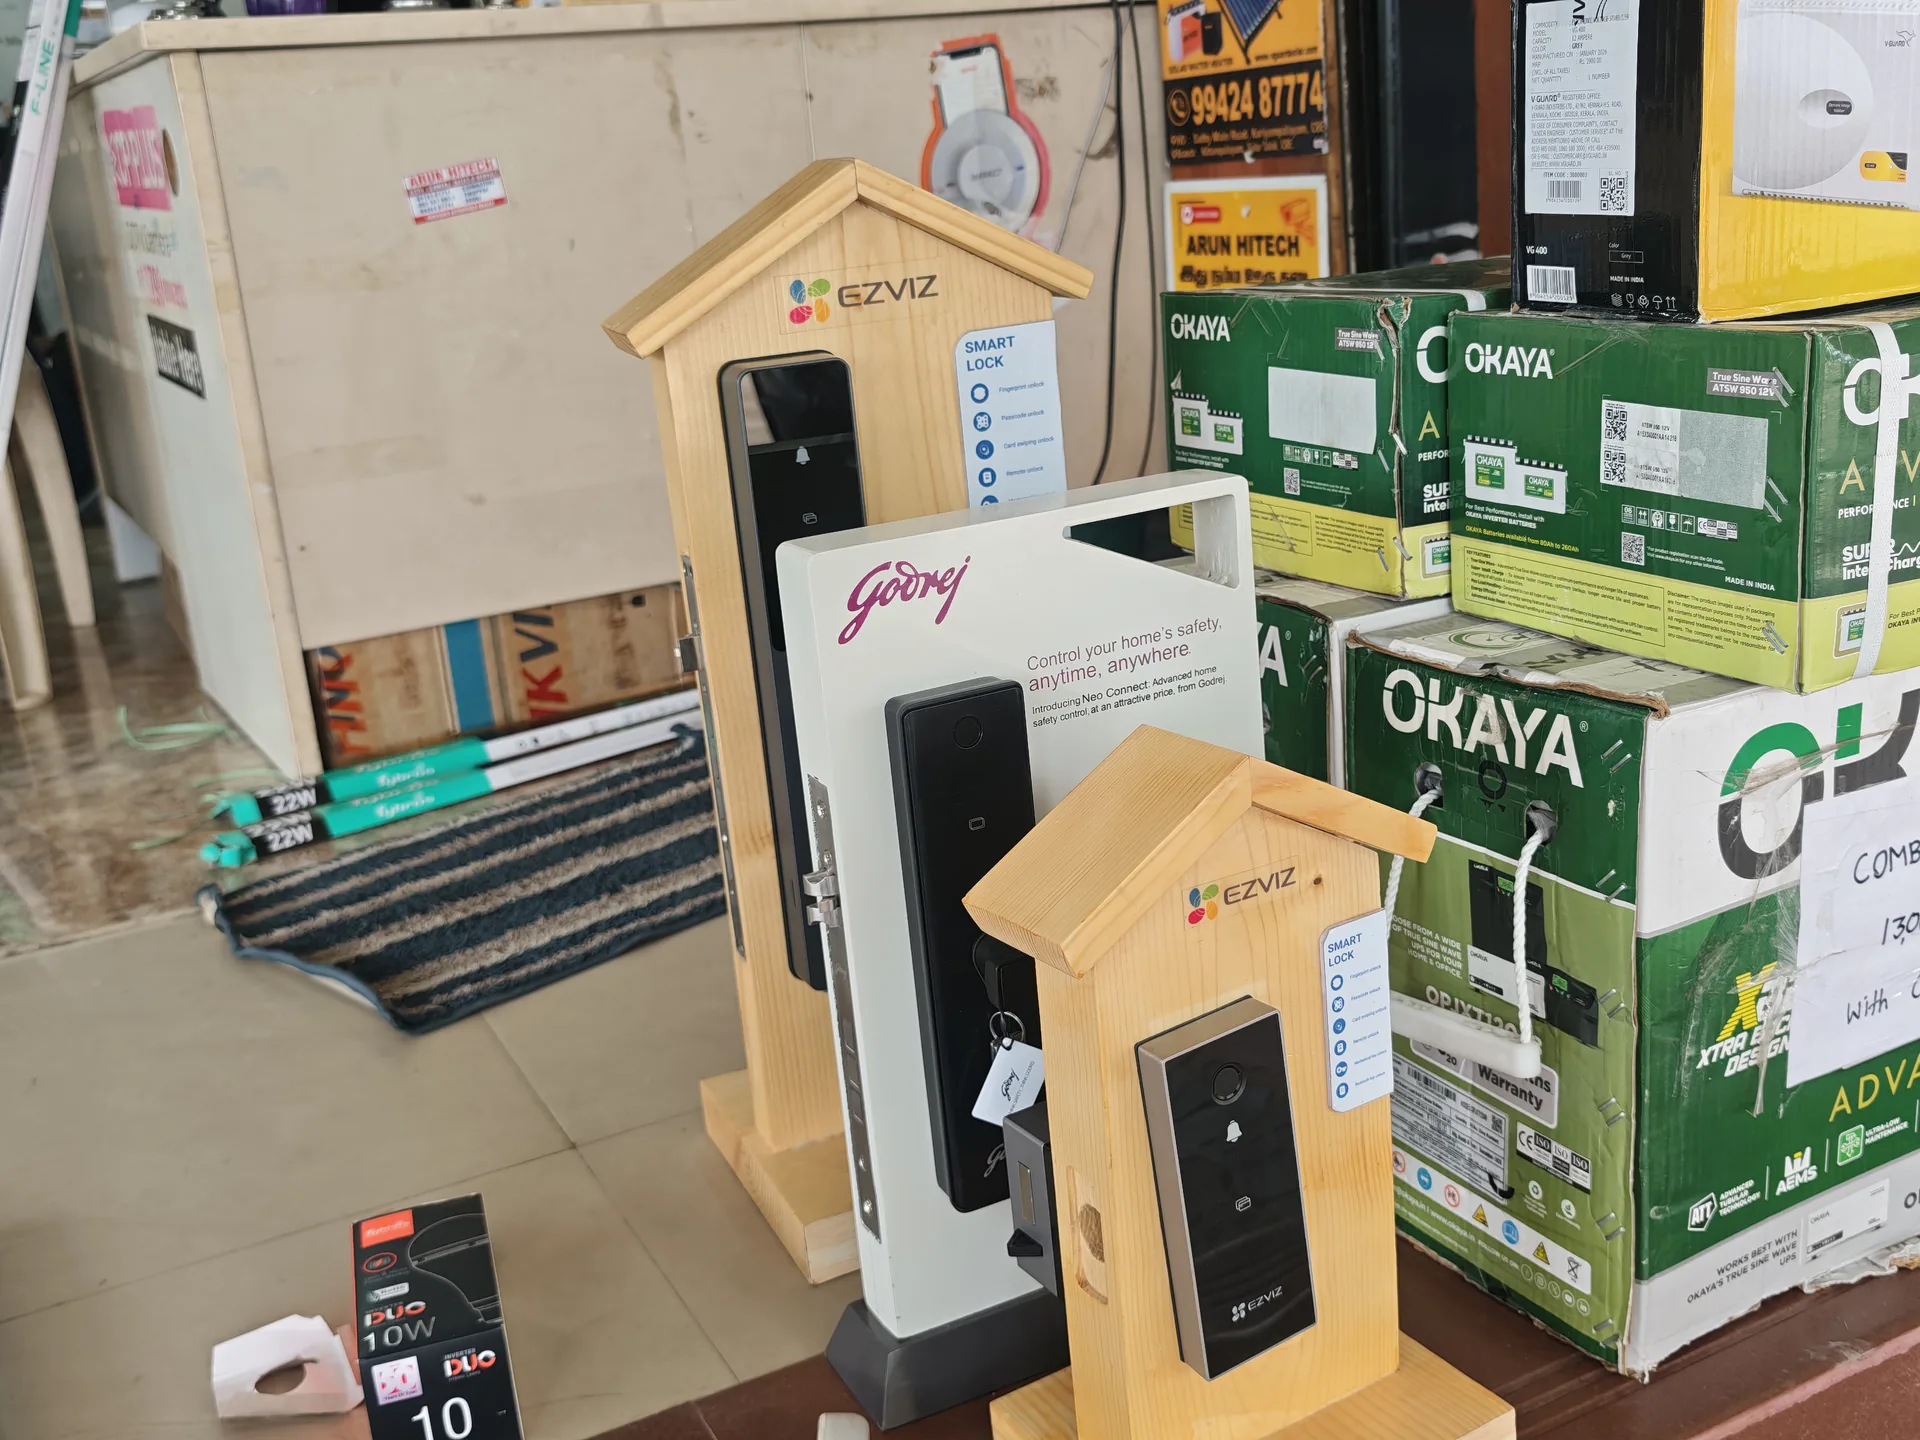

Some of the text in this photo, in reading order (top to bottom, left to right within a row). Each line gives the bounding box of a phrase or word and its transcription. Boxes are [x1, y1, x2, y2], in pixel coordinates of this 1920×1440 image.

[1532, 21, 1558, 29] COMMODITY
[1531, 51, 1566, 60] MANUFACTURED
[1191, 70, 1323, 126] 99424 87774
[1187, 234, 1300, 257] ARUN HITECH
[1526, 245, 1548, 255] VG 400
[837, 274, 939, 308] EZVIZ
[1170, 313, 1231, 342] OKAYA
[965, 335, 1016, 354] SMART
[966, 355, 1004, 372] LOCK
[1465, 342, 1554, 380] OKAYA
[999, 381, 1045, 393] Fingerprint unlock
[1712, 371, 1751, 383] True Sine
[1712, 384, 1757, 396] ATSW 950
[1001, 409, 1045, 421] Passcode unlock
[1003, 436, 1054, 449] Card swiping unlock
[1476, 455, 1503, 468] OKAYA
[1006, 468, 1026, 477] Remote
[1528, 476, 1549, 487] OKAYA
[1465, 511, 1537, 529] OKAYA INVERTER BATTERIES
[1474, 504, 1485, 512] Best
[1485, 505, 1518, 518] Performance,
[1533, 515, 1545, 523] with
[1465, 525, 1482, 534] OKAYA
[1483, 528, 1505, 538] Batteries
[1724, 575, 1775, 591] MADE IN INDIA
[837, 555, 971, 645] Godrej
[1682, 602, 1733, 618] representation purposes
[1699, 597, 1775, 618] product packaging
[1888, 619, 1909, 629] OKAYA
[1889, 609, 1916, 621] For Best
[1695, 621, 1720, 632] trademarks
[1027, 617, 1222, 671] Control your home's safety,
[1694, 629, 1767, 650] company responsible
[1029, 643, 1192, 692] anytime, anywhere.
[1032, 665, 1217, 714] Introducing Neo Connect: Advanced home
[1032, 674, 1228, 728] safety control, at an attractive price, from Godrej.
[1383, 668, 1584, 788] OKAYA
[270, 787, 316, 816] 22W
[266, 822, 313, 852] 22W
[1223, 866, 1297, 906] EZVIZ
[1328, 933, 1363, 953] SMART
[1392, 923, 1462, 960] OF TRUE SINE WAVE
[1413, 923, 1462, 951] FROM A WIDE
[1328, 950, 1355, 967] LOCK
[1407, 948, 1428, 964] HOME
[1411, 941, 1462, 970] UPS FOR YOUR
[1469, 950, 1488, 963] OKAYA
[1369, 964, 1382, 972] unlock
[1369, 986, 1381, 994] unlock
[1375, 1006, 1387, 1014] unlock
[1847, 987, 1888, 1025] With
[1696, 1031, 1749, 1070] XTRA
[1724, 1034, 1790, 1078] DESGN
[1478, 1063, 1543, 1112] Warranty
[1865, 1117, 1901, 1137] ULTRA-LOW
[1865, 1121, 1909, 1145] MAINTENANCE
[1536, 1135, 1588, 1171] ISO ISO ISO
[1720, 1179, 1755, 1199] ADVANCED
[1776, 1166, 1818, 1196] AEMS
[1719, 1190, 1750, 1208] TUBULAR
[1719, 1191, 1761, 1217] TECHNOLOGY
[1691, 1201, 1713, 1226] ATT
[1716, 1229, 1798, 1276] WORKS BEST WITH
[1779, 1252, 1797, 1266] UPS
[1687, 1241, 1797, 1303] OKAYA'S TRUE SINE WAVE
[1247, 1285, 1283, 1311] EZVIZ
[363, 1301, 427, 1328] DUO
[362, 1316, 436, 1352] 10W
[443, 1350, 497, 1378] DUO
[444, 1347, 476, 1360] INVERTER
[411, 1396, 473, 1440] 10
